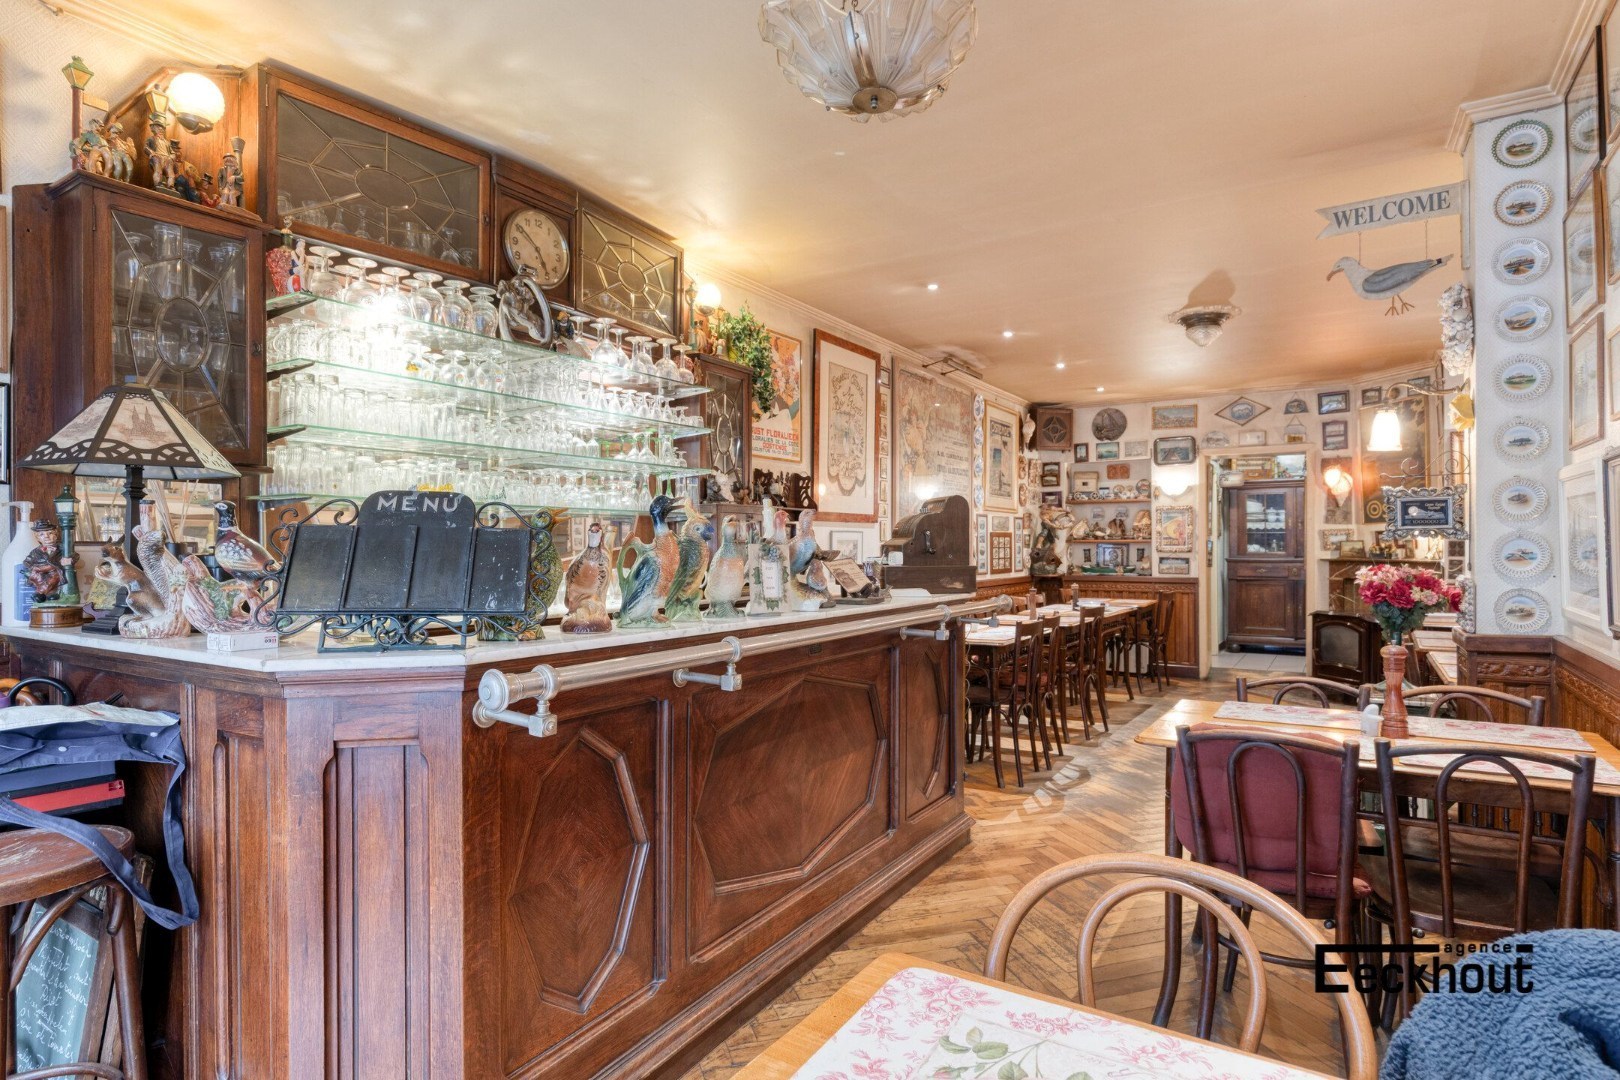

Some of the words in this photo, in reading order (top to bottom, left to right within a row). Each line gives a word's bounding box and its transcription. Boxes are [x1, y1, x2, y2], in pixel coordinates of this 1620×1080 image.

[1333, 190, 1451, 229] WELCOME
[525, 218, 531, 227] 11
[535, 219, 543, 229] 12
[512, 236, 519, 245] 9
[553, 240, 560, 248] 2
[514, 250, 521, 260] 8
[555, 253, 561, 263] 3
[377, 495, 459, 512] MENU
